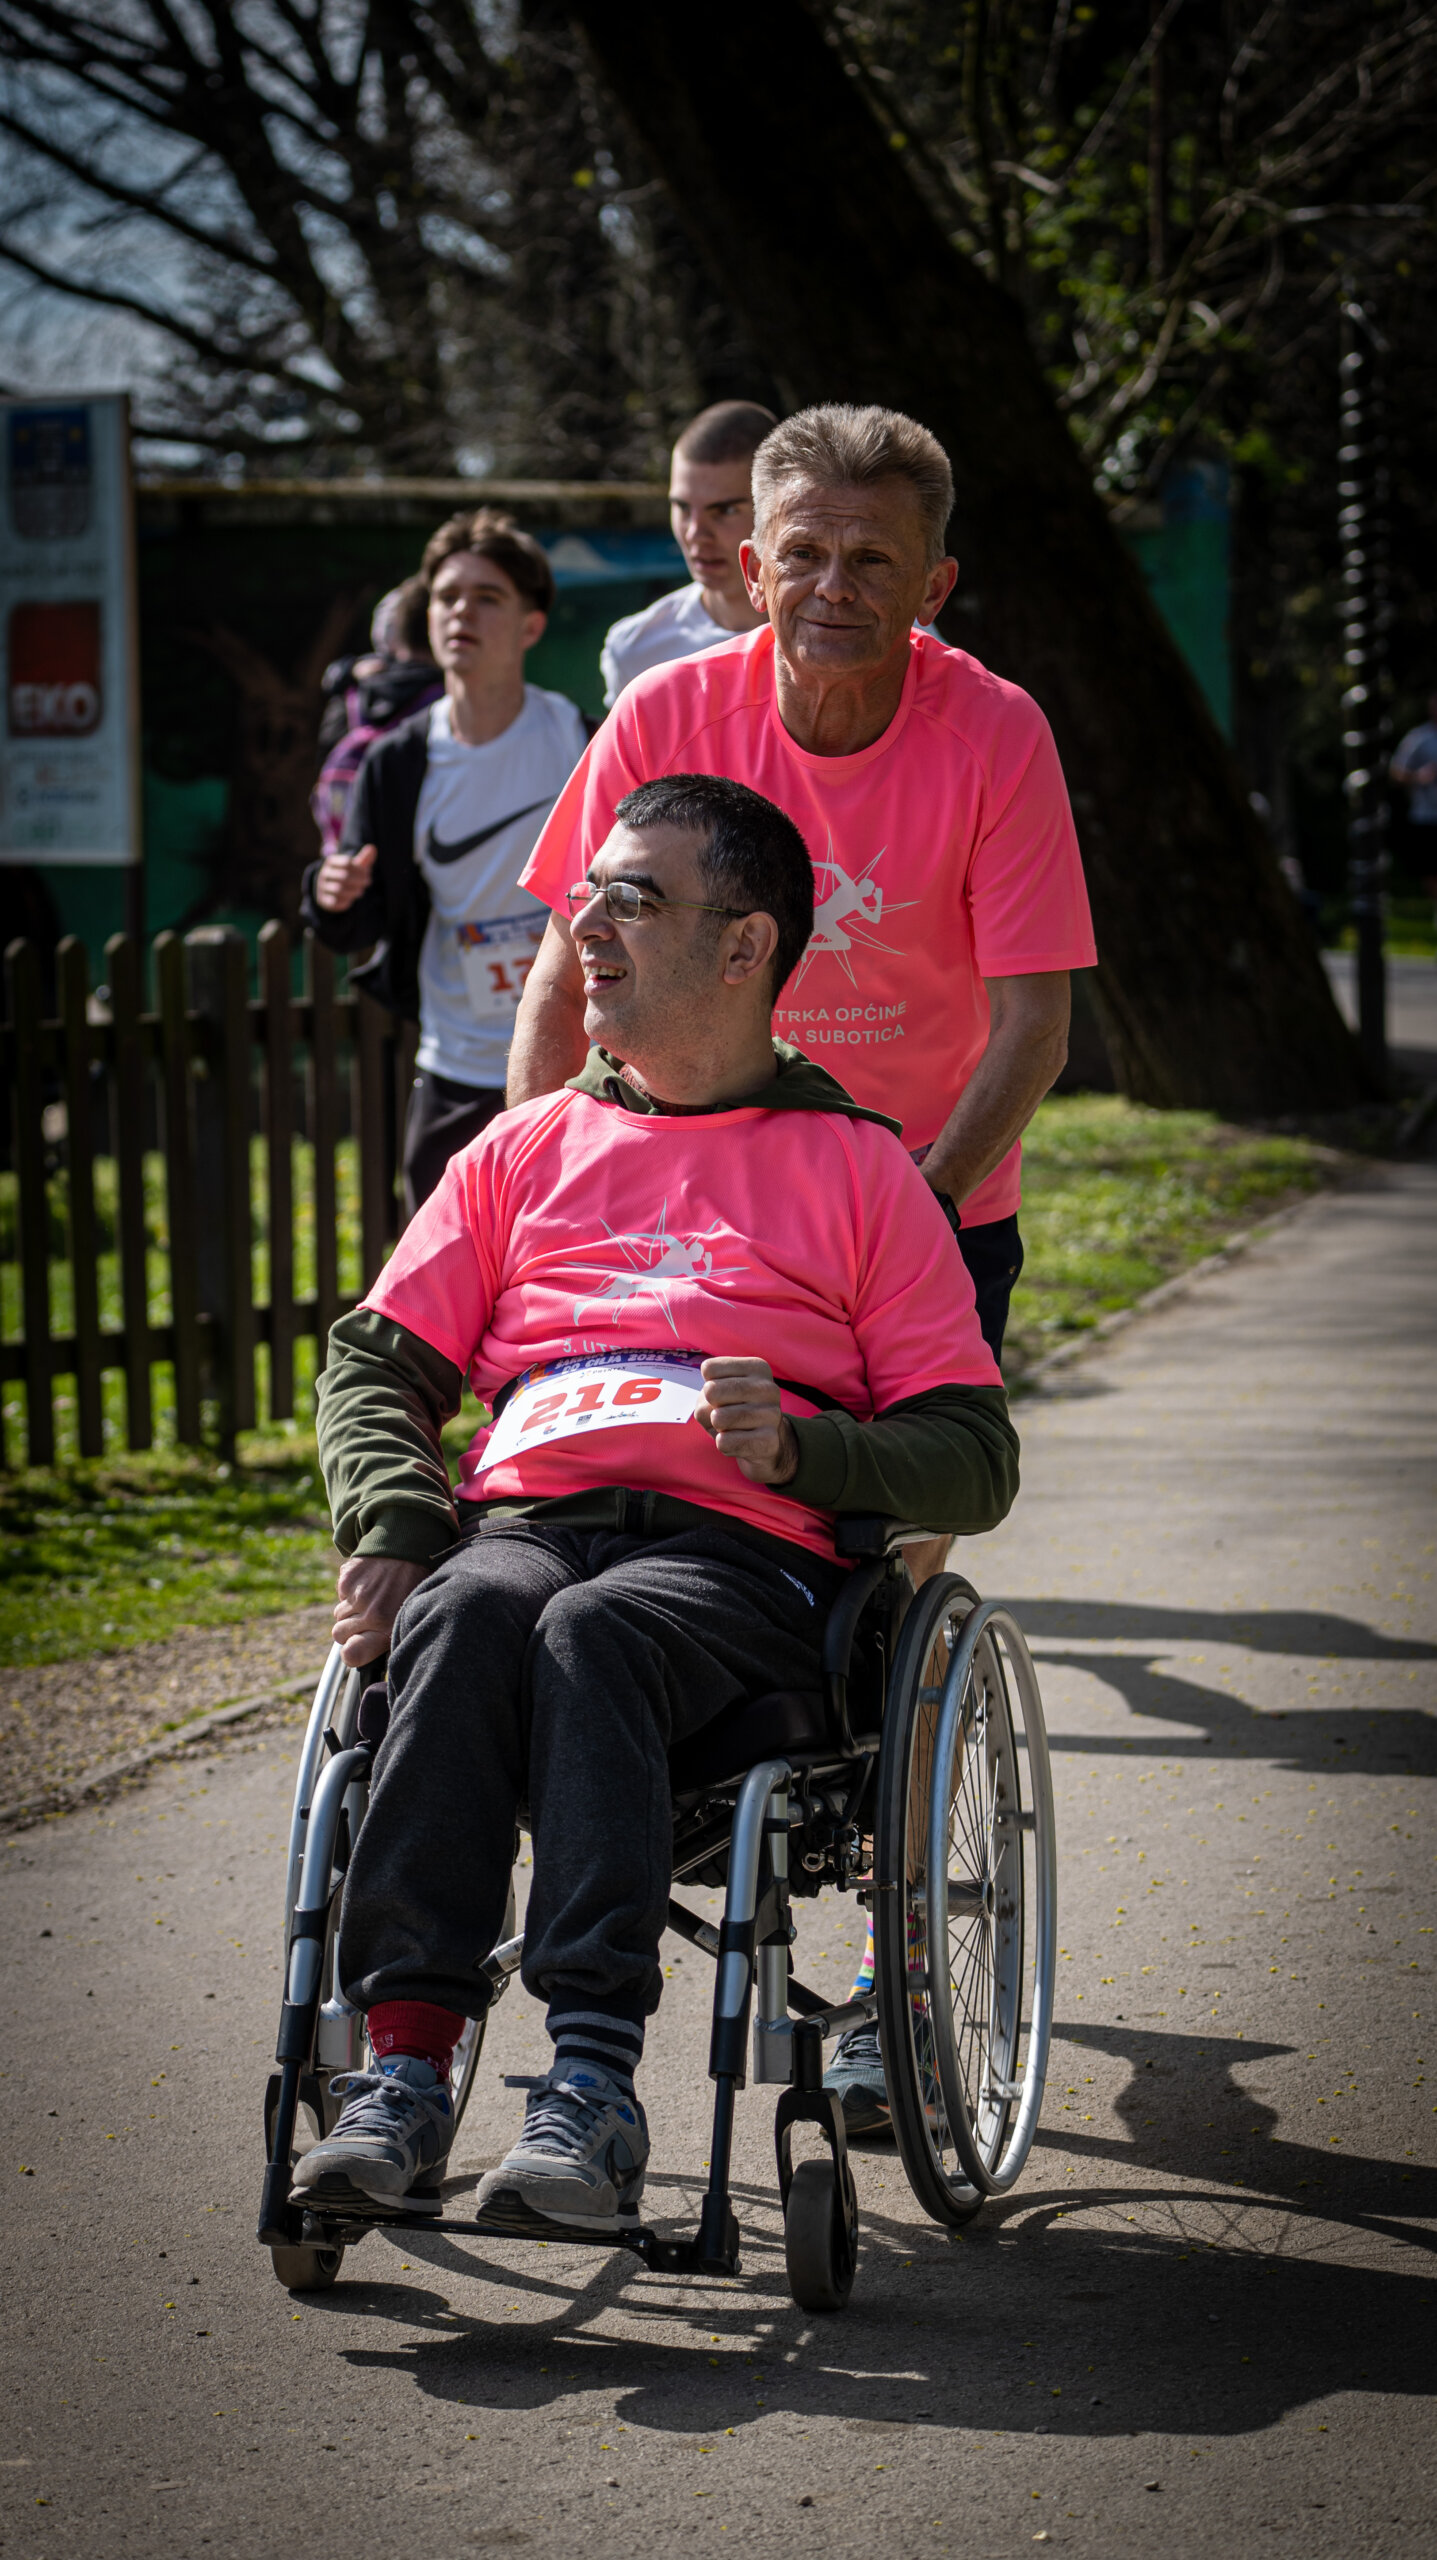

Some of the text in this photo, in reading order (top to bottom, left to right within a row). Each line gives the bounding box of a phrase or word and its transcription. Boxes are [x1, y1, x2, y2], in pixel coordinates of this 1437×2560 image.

[12, 682, 98, 729] EKO
[770, 1001, 907, 1023] TRKA OPĆINE
[805, 1024, 905, 1045] SUBOTICA
[562, 1338, 577, 1353] 5.
[562, 1363, 581, 1375] DO
[585, 1355, 622, 1368] CILJA
[520, 1378, 663, 1433] 216
